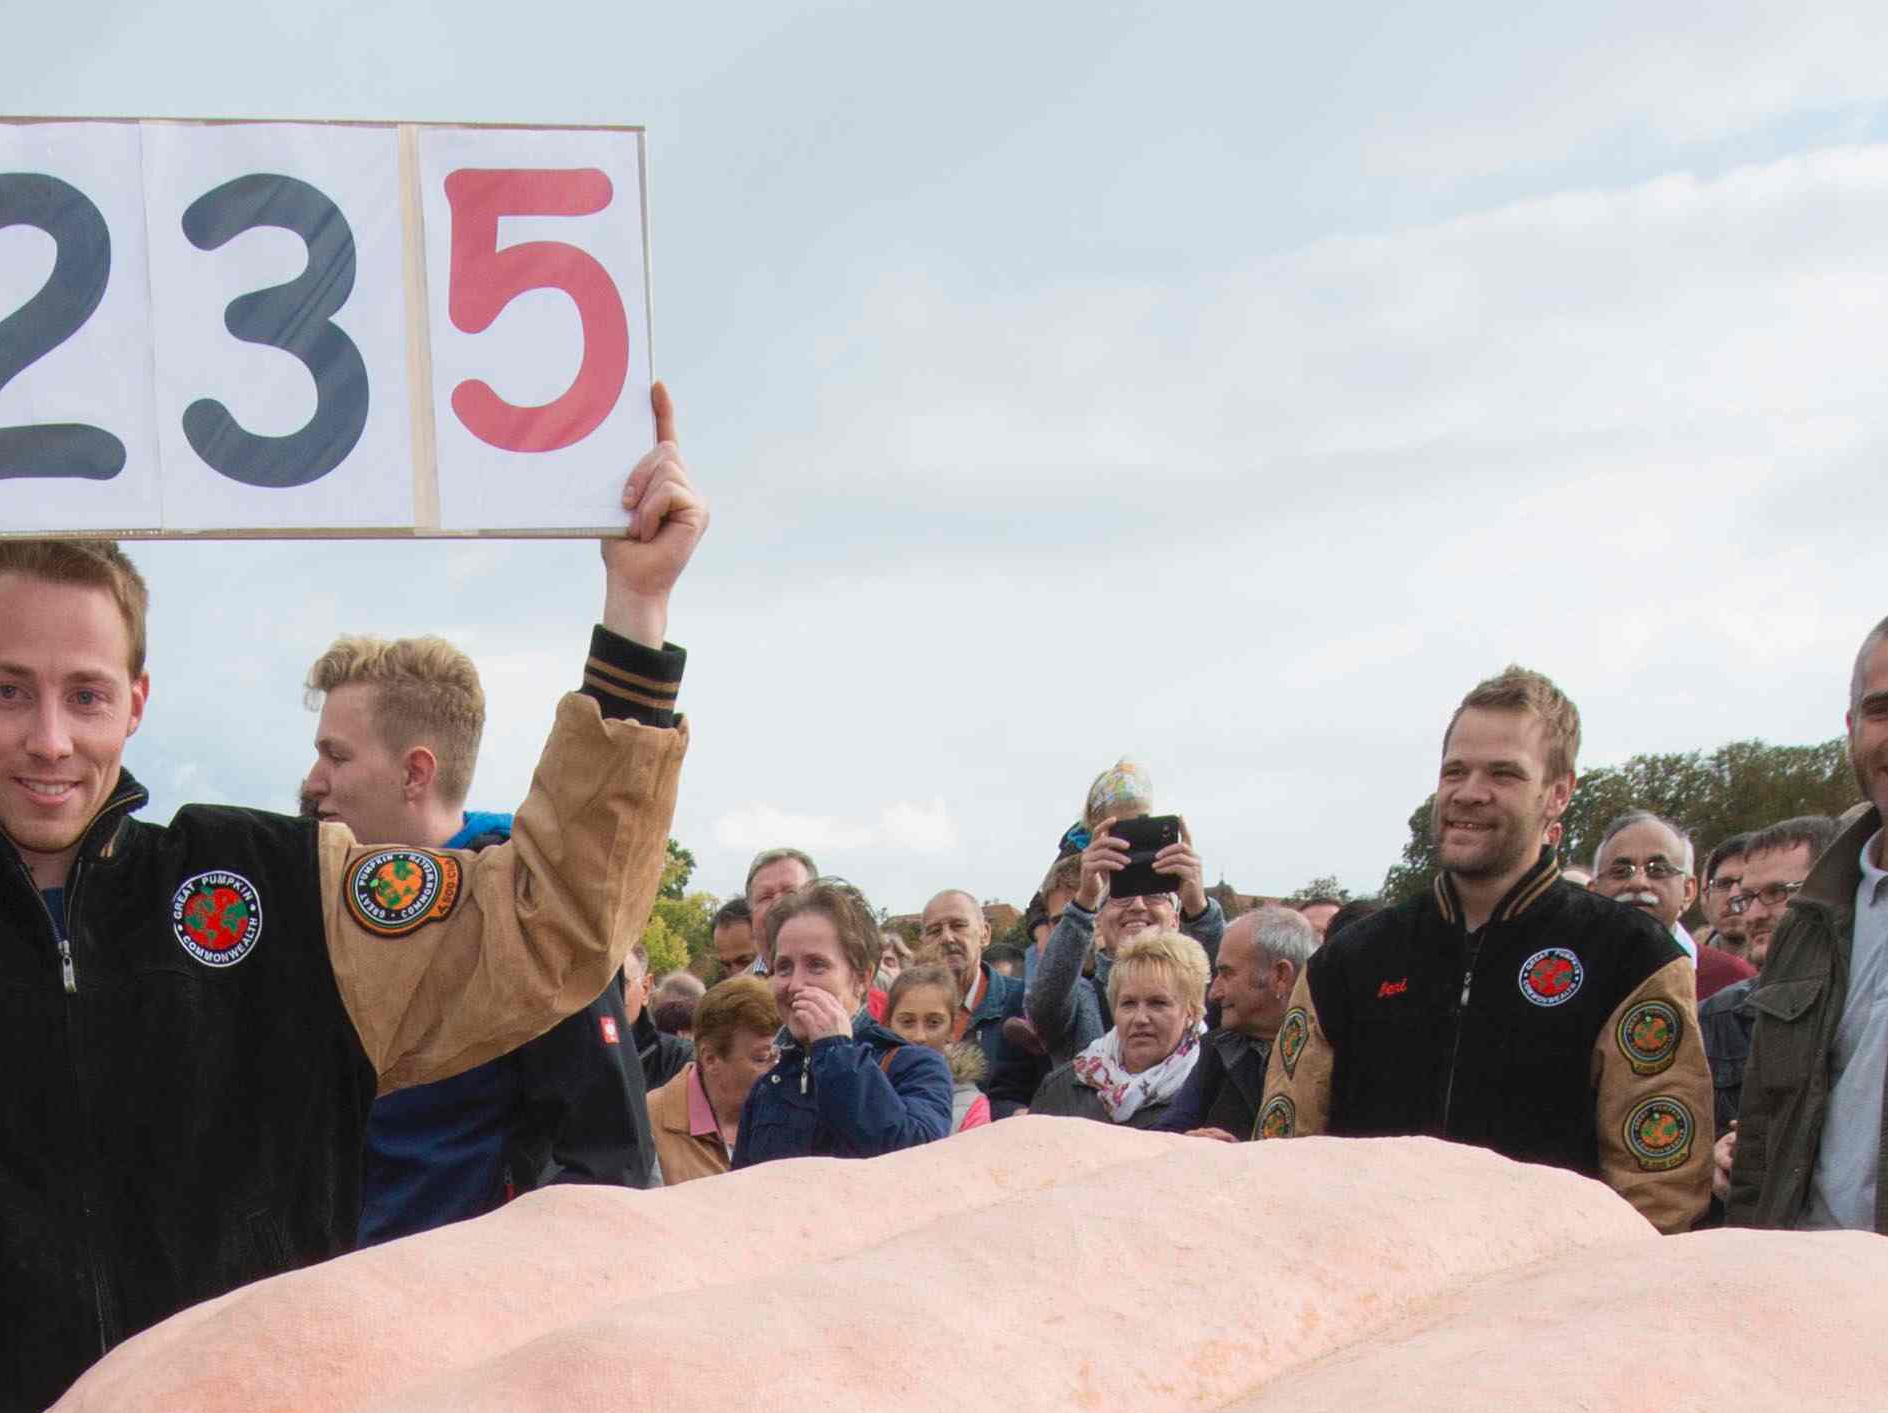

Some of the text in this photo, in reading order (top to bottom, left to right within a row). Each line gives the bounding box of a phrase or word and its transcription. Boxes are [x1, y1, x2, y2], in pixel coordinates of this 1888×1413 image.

[173, 874, 254, 920] GREAT PUMPKIN
[357, 854, 394, 919] GREAT PUMPKIN
[400, 854, 435, 919] COMMONWEALTH
[182, 917, 258, 962] COMMONWEALTH
